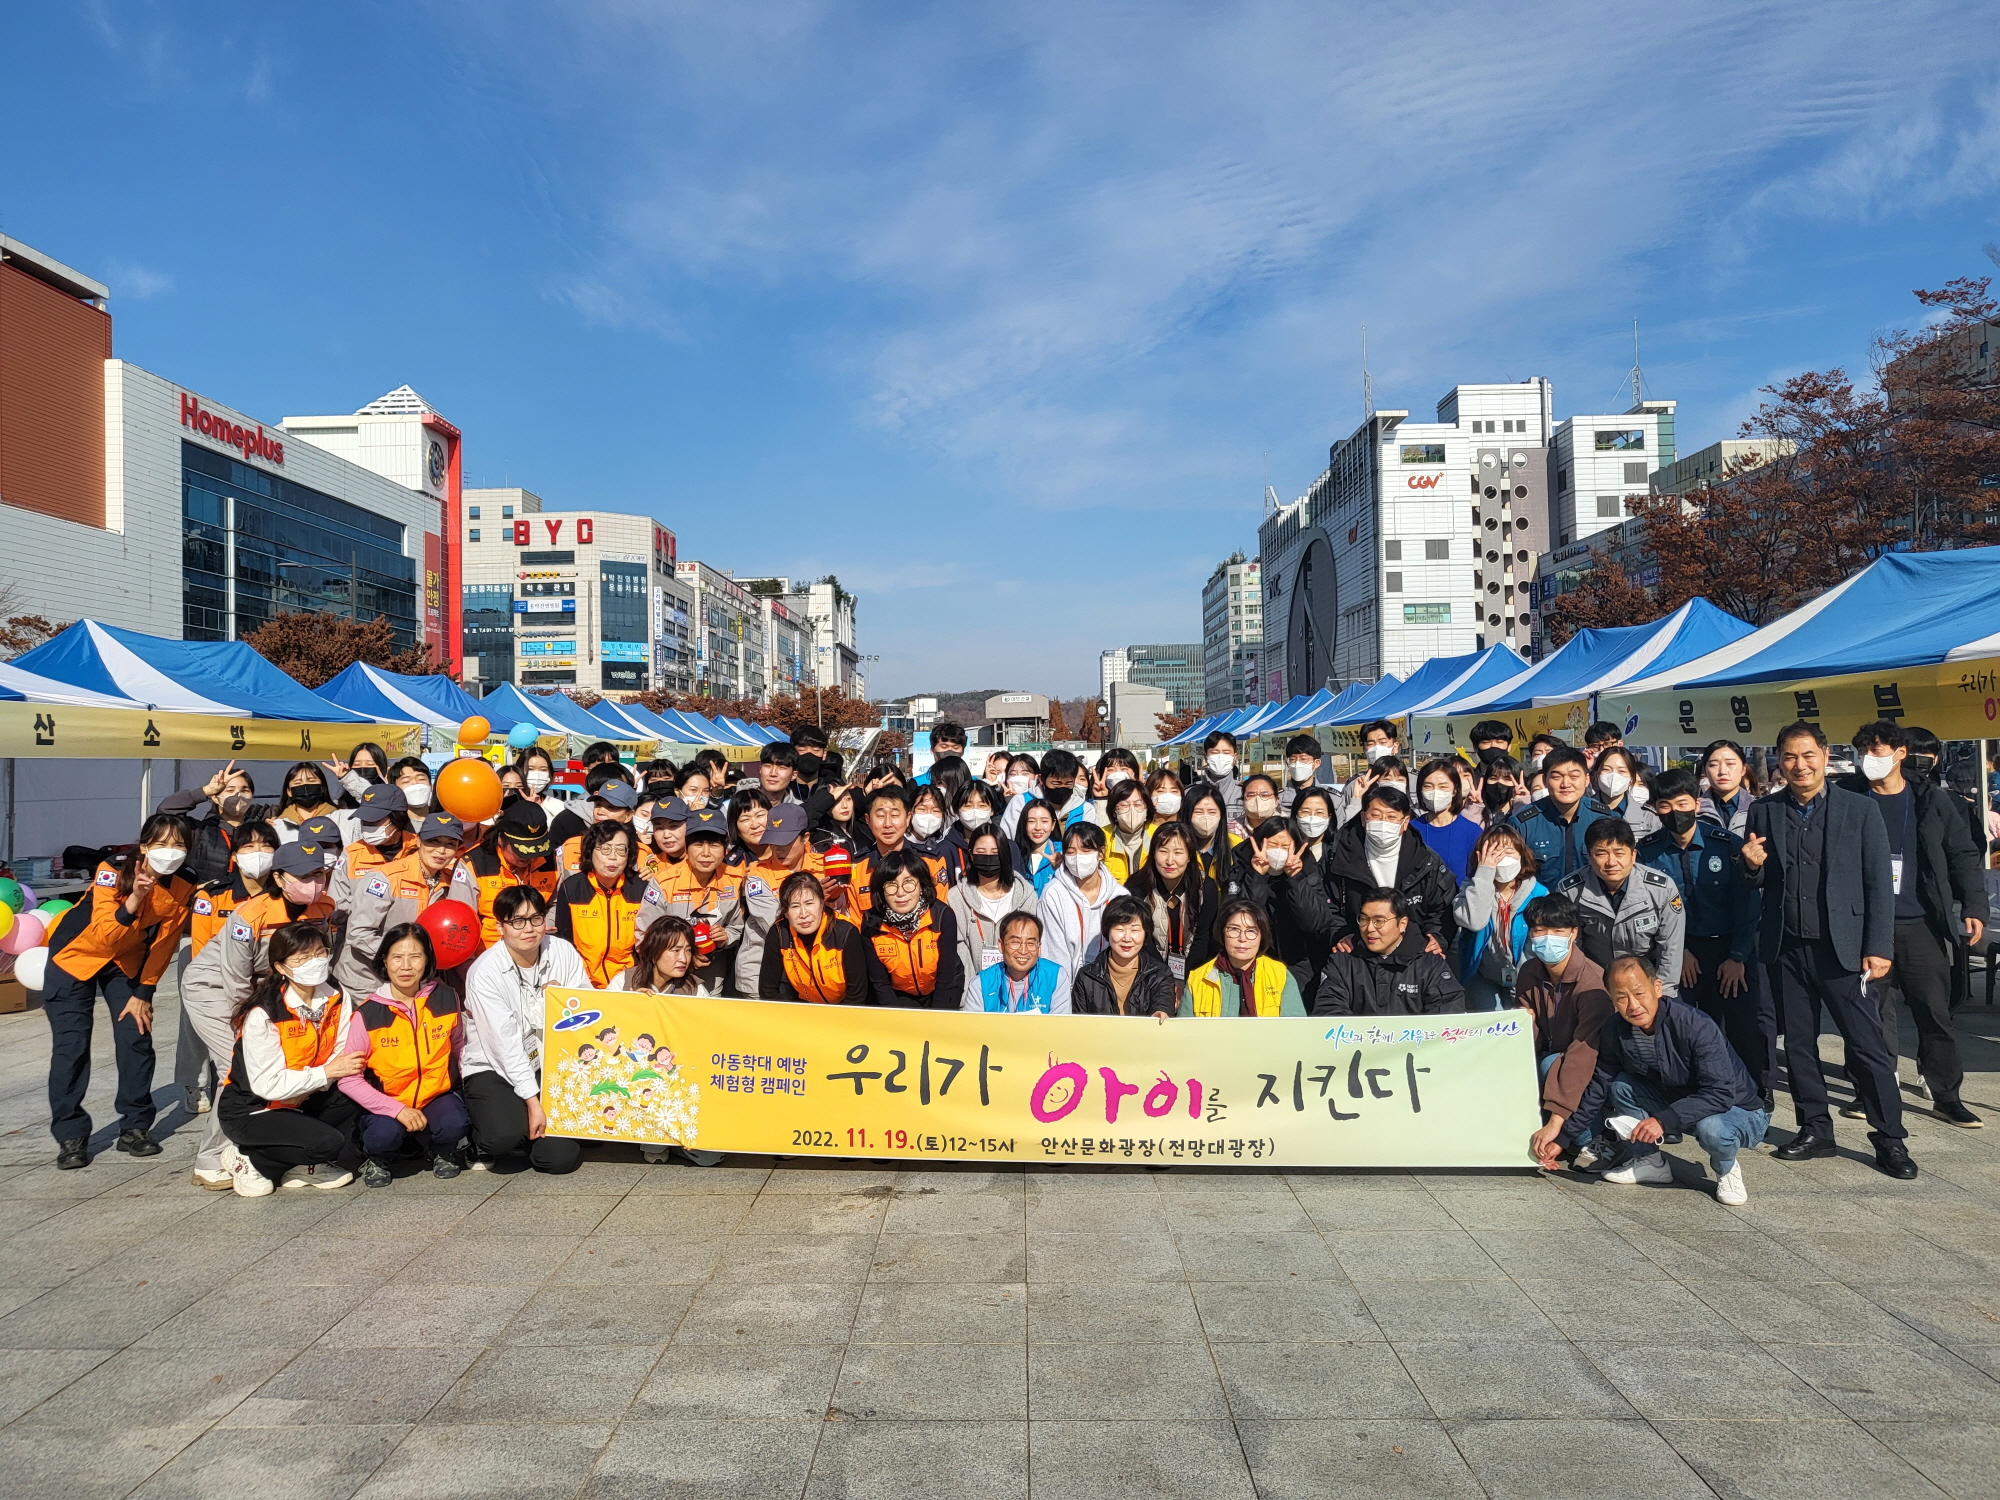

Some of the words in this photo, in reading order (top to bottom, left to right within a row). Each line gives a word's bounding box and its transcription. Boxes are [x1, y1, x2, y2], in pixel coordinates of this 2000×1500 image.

[180, 392, 284, 464] Homeplus
[1408, 475, 1440, 489] CGV
[514, 518, 593, 545] BYC
[426, 570, 439, 589] 물가
[426, 589, 439, 608] 안정
[611, 670, 637, 680] wells
[1958, 669, 1996, 694] 우리가
[380, 1037, 399, 1048] 안산
[1325, 1024, 1365, 1050] 시민과
[1398, 1029, 1437, 1047] 자유로운
[1440, 1027, 1482, 1045] 혁신도시
[1486, 1021, 1522, 1037] 안산
[710, 1053, 773, 1073] 아동학대
[776, 1056, 808, 1076] 예방
[709, 1073, 756, 1094] 체험형
[760, 1076, 807, 1097] 캠페인
[826, 1040, 1003, 1106] 우리가
[1028, 1050, 1228, 1124] 아이를
[1256, 1049, 1431, 1121] 지킨다
[792, 1129, 838, 1148] 2022.
[846, 1127, 874, 1149] 11.
